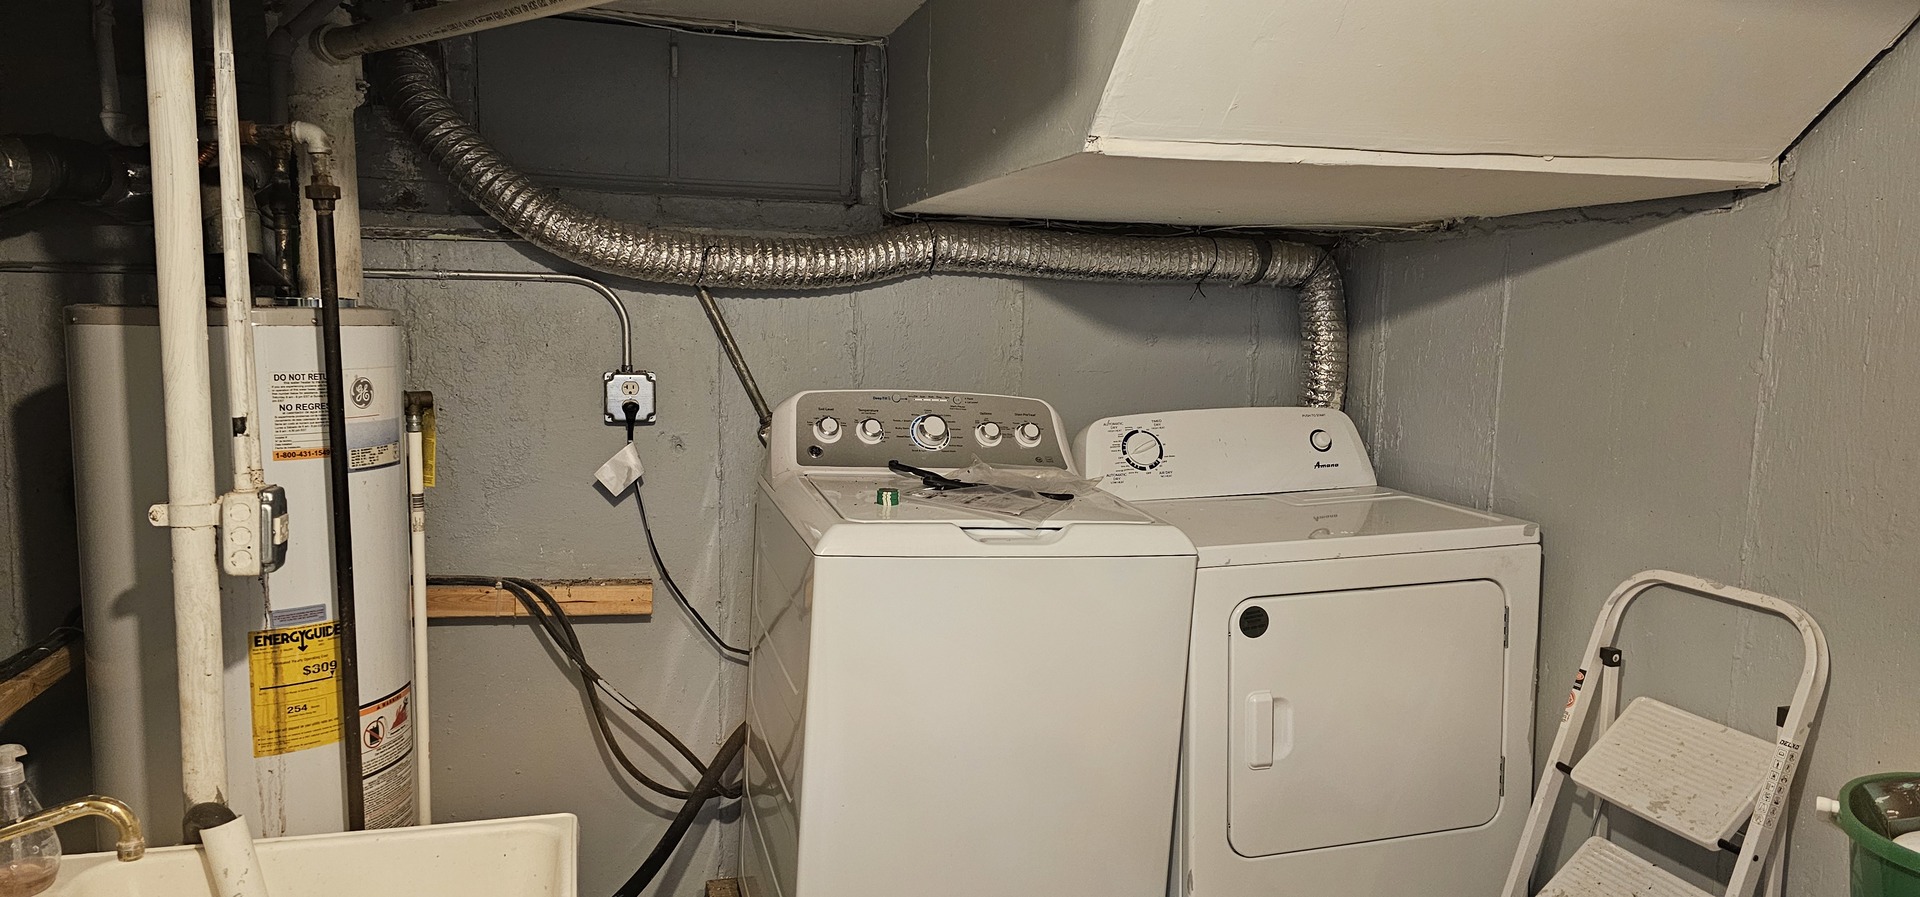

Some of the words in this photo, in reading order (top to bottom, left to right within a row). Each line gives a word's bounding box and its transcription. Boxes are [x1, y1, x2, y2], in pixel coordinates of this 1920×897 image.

[1314, 461, 1339, 469] Amana
[254, 624, 340, 651] ENERGYGUIDE
[303, 660, 337, 676] $309
[287, 704, 308, 714] 254
